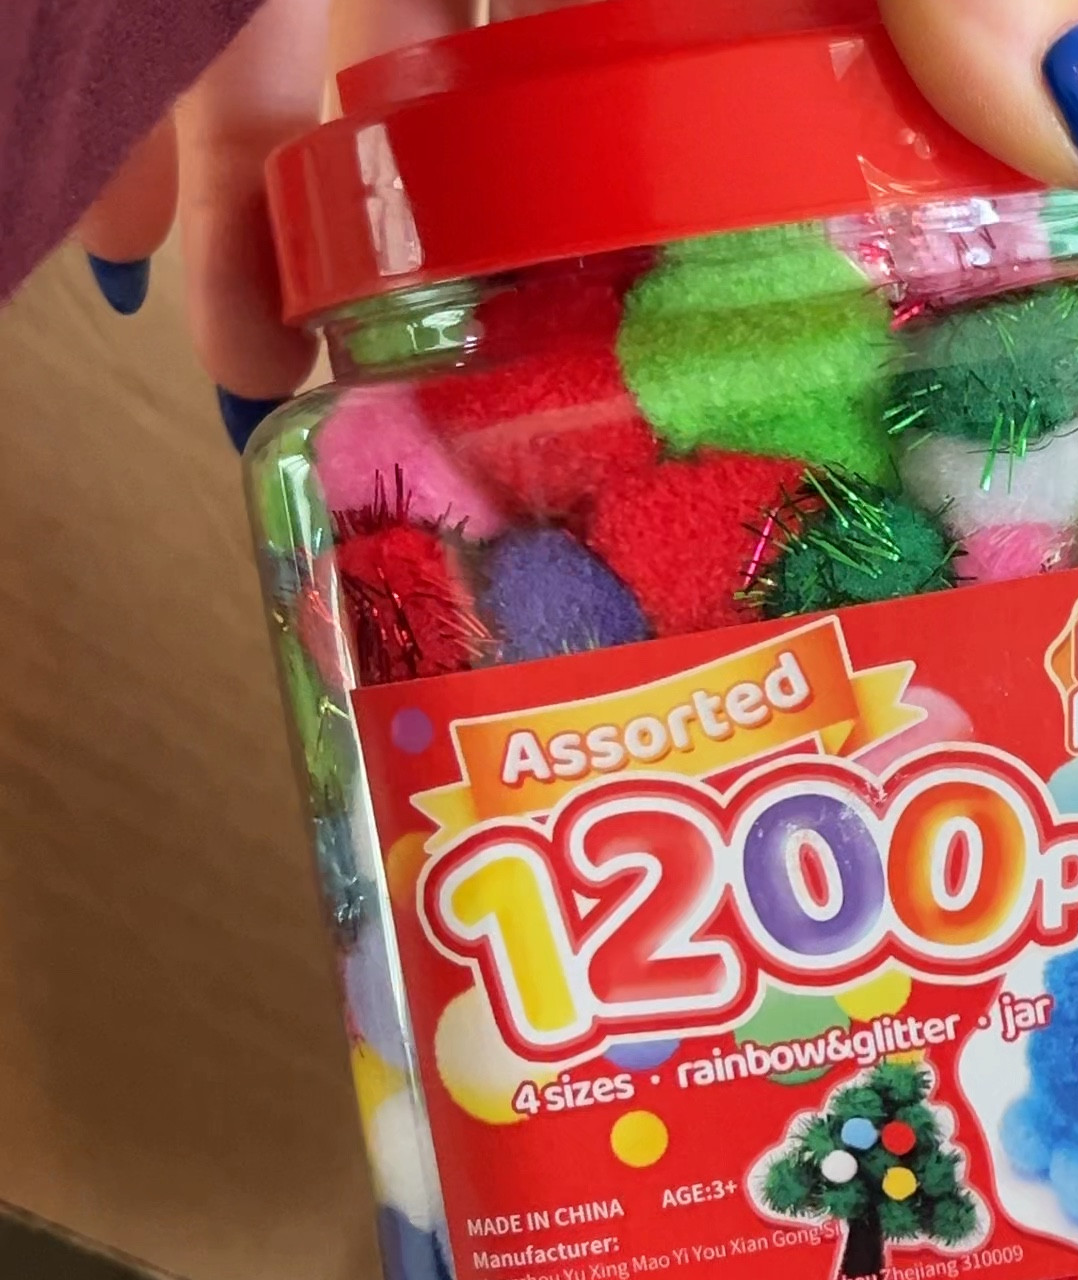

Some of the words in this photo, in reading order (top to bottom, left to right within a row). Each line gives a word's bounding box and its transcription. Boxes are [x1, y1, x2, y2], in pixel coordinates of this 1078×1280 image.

[502, 651, 811, 784] Assorted
[514, 1083, 540, 1115] 4
[544, 1071, 635, 1112] sizes
[677, 1013, 961, 1089] rainbow&glitter
[1000, 993, 1052, 1041] jar
[662, 1179, 738, 1208] AGE:3+
[467, 1214, 523, 1237] MADE
[527, 1210, 550, 1231] IN
[554, 1198, 625, 1227] CHINA
[473, 1235, 620, 1270] Manufacturer:
[589, 1261, 630, 1280] Xing
[632, 1254, 670, 1272] Mao
[672, 1248, 690, 1265] Yi
[691, 1243, 726, 1262] You
[730, 1237, 768, 1255] Xian
[772, 1227, 821, 1247] Gong
[962, 1245, 1024, 1272] 310009
